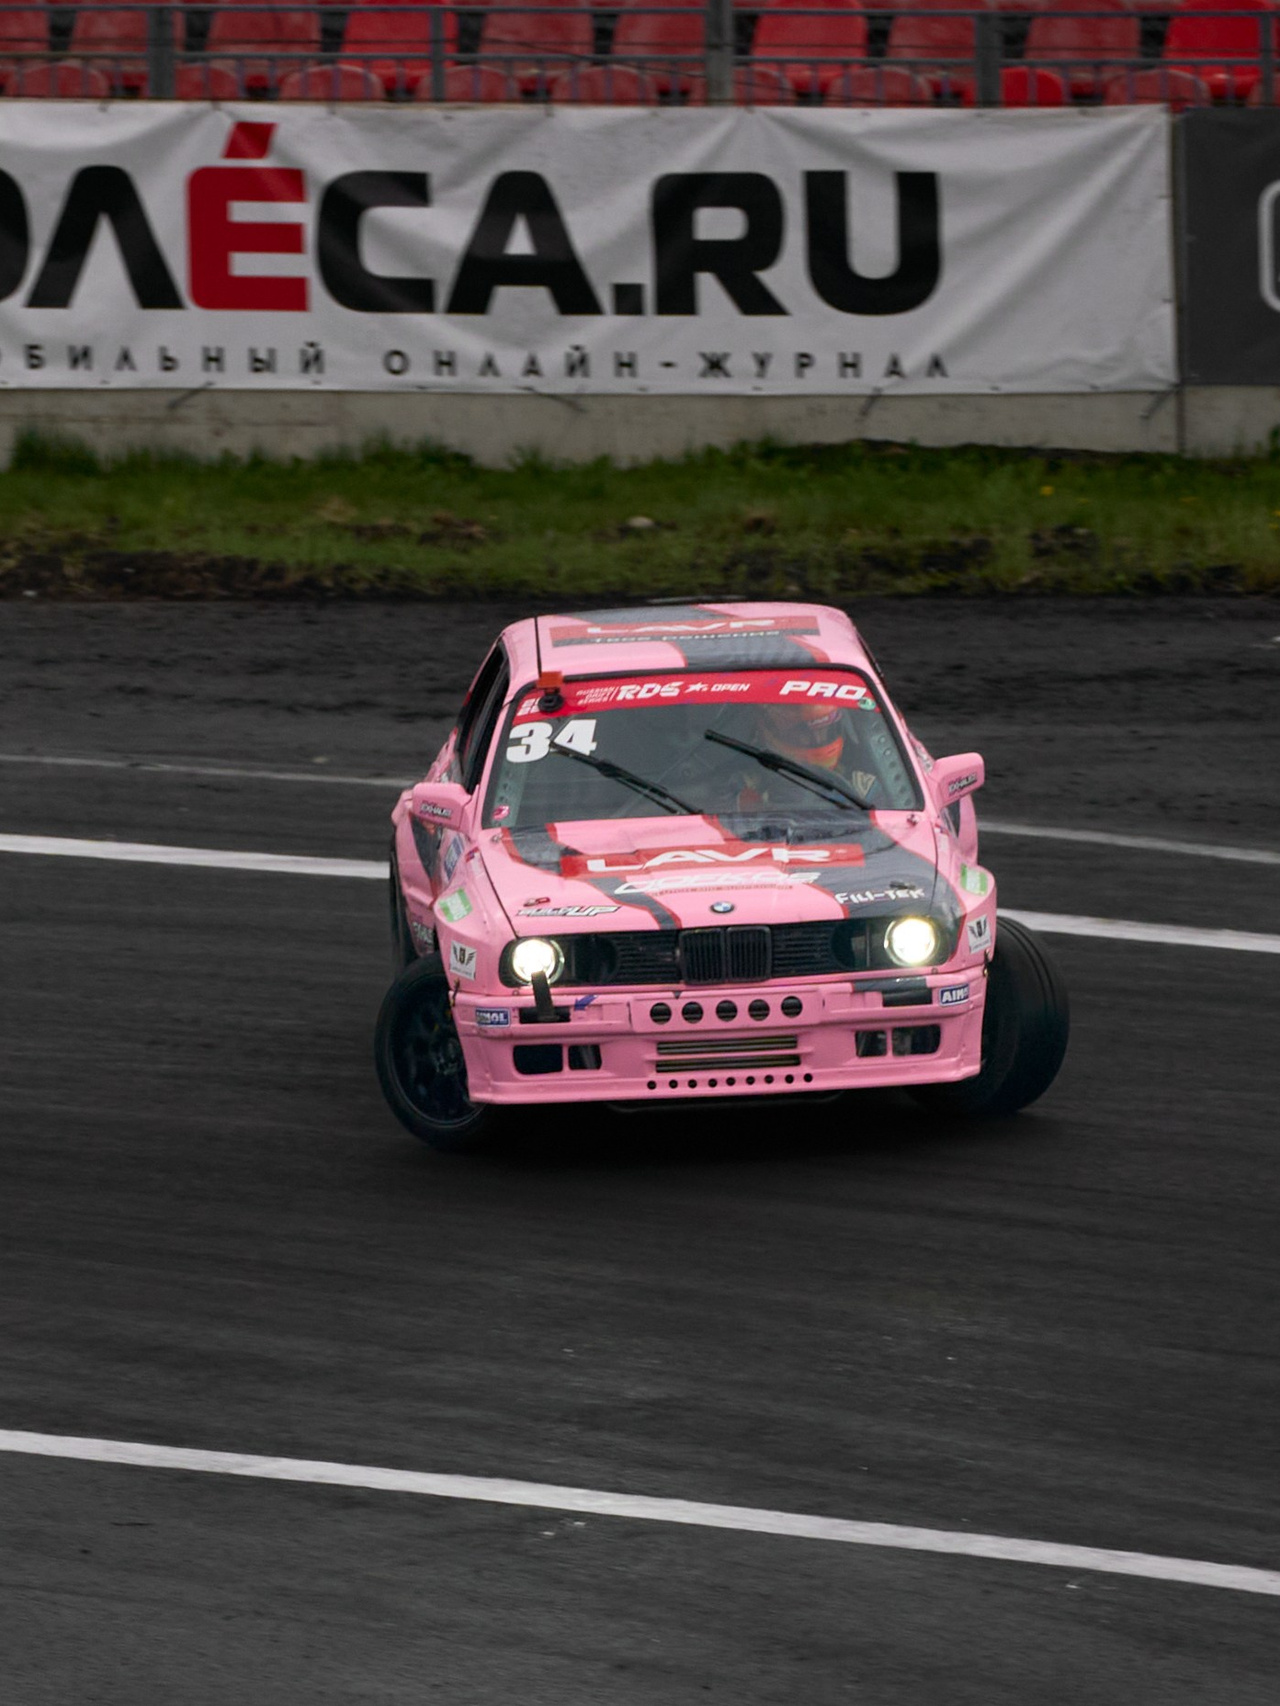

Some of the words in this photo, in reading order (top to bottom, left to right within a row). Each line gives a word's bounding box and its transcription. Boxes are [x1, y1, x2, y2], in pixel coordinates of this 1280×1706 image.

[382, 344, 950, 380] ОНЛАЙН-ЖУРНАЛ
[617, 681, 685, 701] RDS
[710, 683, 750, 693] OPEN
[779, 680, 867, 700] PRO
[506, 719, 597, 763] 34
[586, 847, 831, 872] LAVR
